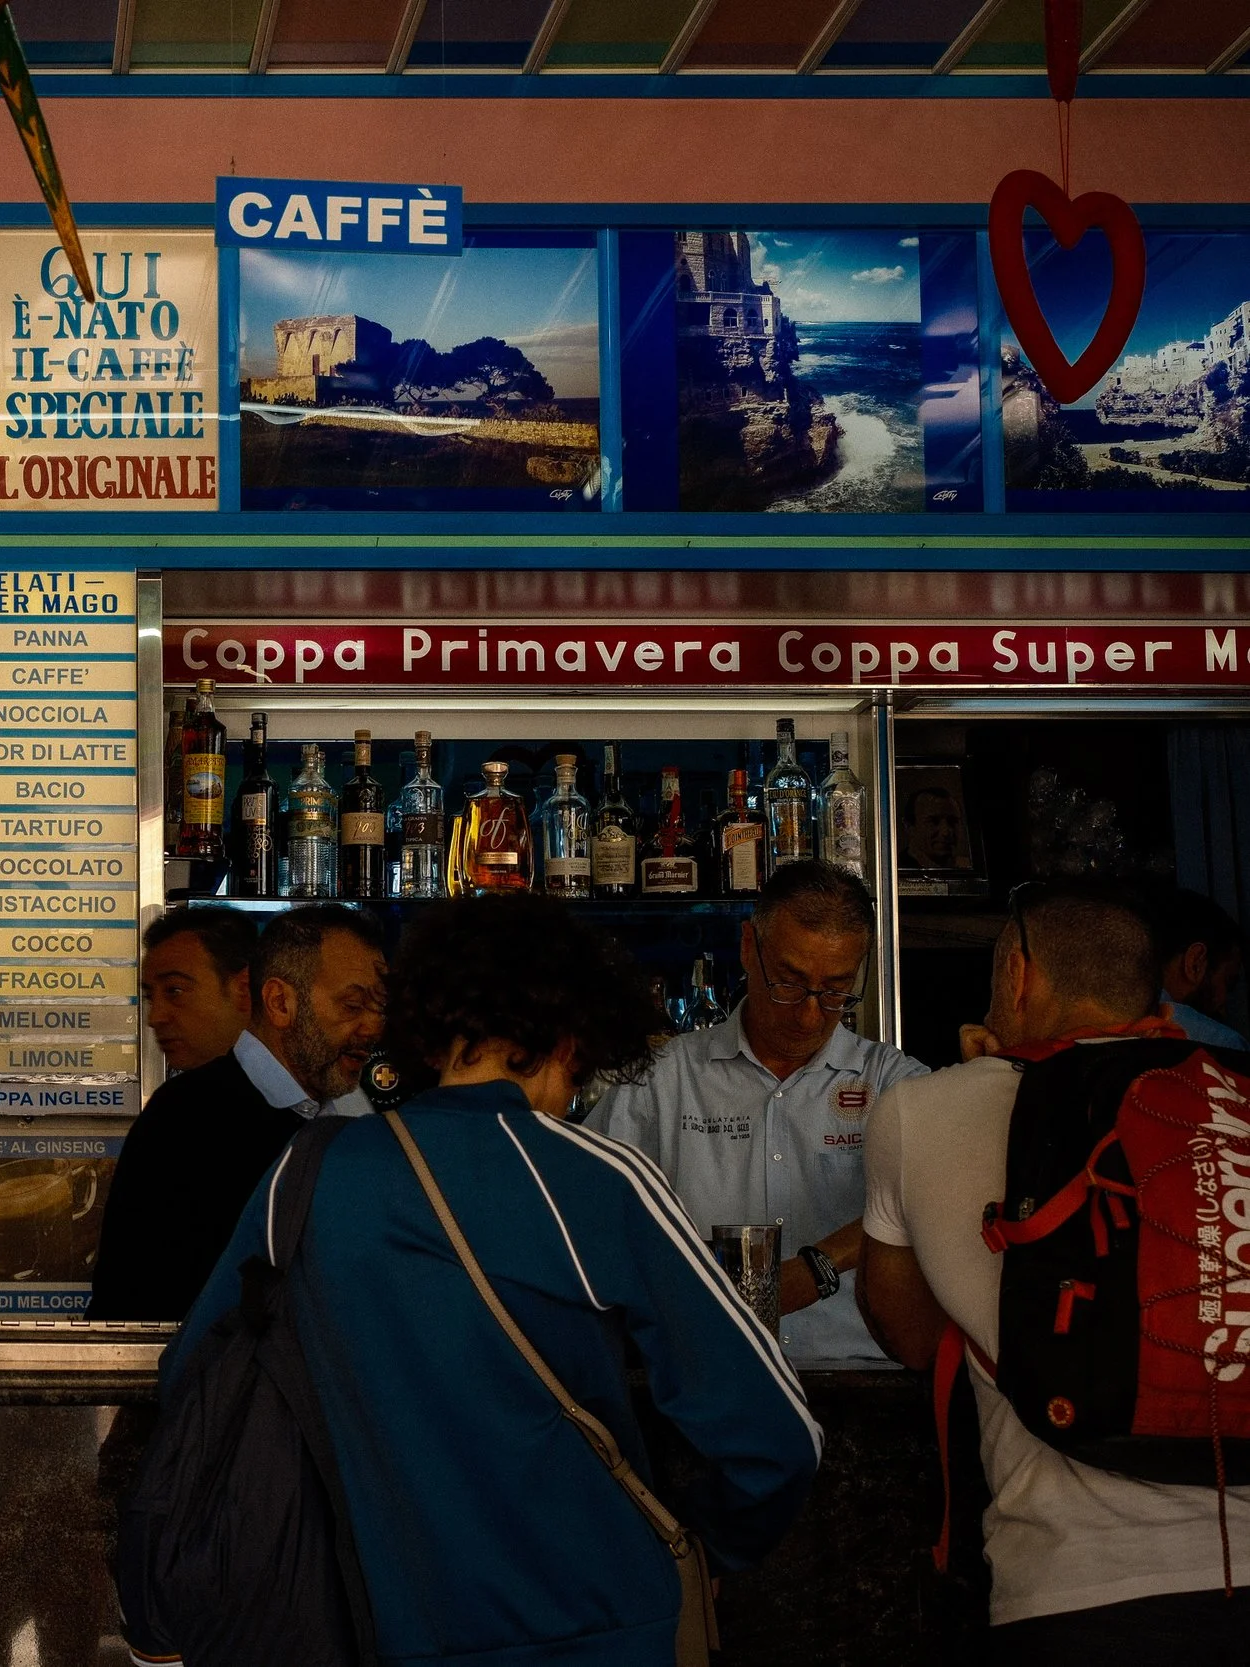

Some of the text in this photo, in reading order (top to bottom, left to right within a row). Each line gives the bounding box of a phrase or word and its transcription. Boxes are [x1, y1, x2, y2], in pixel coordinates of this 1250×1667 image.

[228, 187, 448, 246] CAFFÈ
[40, 246, 161, 300] QUI
[6, 391, 204, 440] SPECIALE
[42, 594, 118, 613] MAGO
[13, 630, 88, 647] PANNA
[182, 627, 1250, 685] Coppa Primavera Coppa Super M
[12, 668, 90, 684] CAFFE'
[32, 744, 52, 760] DI
[60, 744, 127, 761] LATTE
[16, 781, 85, 799] BACIO
[1, 819, 103, 836] TARTUFO
[11, 935, 93, 953] COCCO
[9, 1050, 93, 1067] LIMONE
[40, 1091, 124, 1106] INGLESE
[11, 1141, 31, 1153] AL
[35, 1141, 106, 1154] GINSENG
[823, 1133, 862, 1145] SAIC
